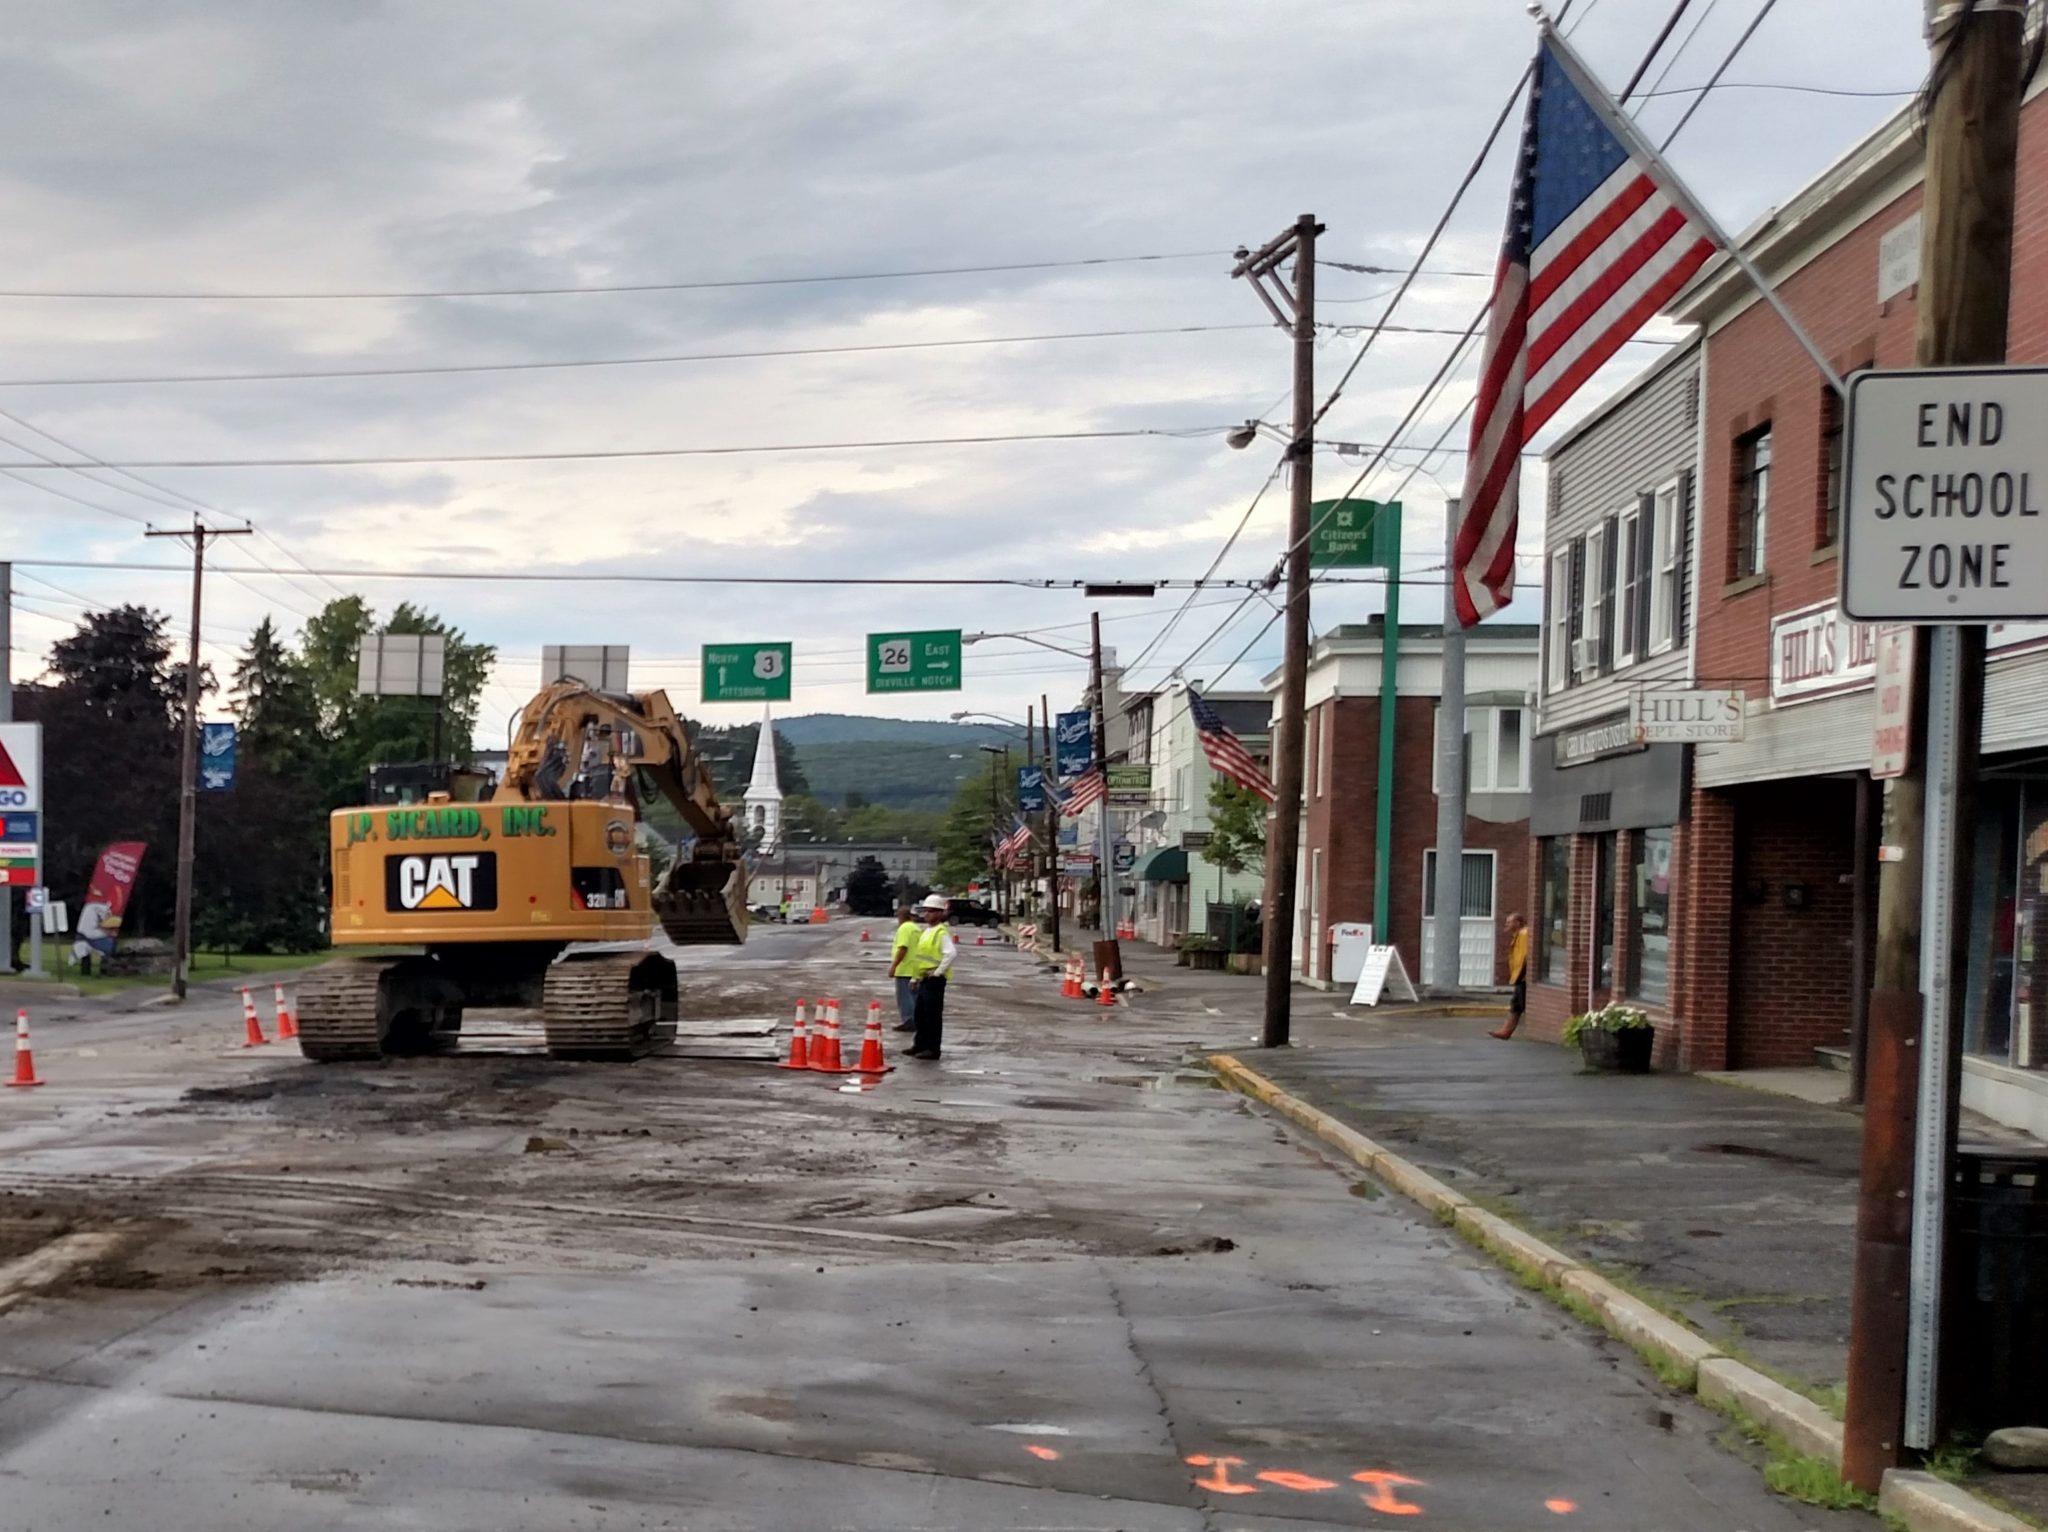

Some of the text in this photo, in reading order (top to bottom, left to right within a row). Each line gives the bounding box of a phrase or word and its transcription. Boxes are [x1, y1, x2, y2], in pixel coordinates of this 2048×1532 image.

[1917, 402, 2003, 447] END
[1874, 472, 2039, 519] SCHOOL
[1320, 529, 1367, 540] Citizens
[1328, 541, 1358, 553] Bank
[1898, 543, 2011, 589] ZONE
[884, 647, 909, 665] 26
[1780, 617, 1836, 684] HILL'S
[762, 655, 775, 673] 3
[719, 686, 767, 696] PITTSBURG
[875, 675, 953, 688] DIXVILLE NOTCH
[1637, 698, 1740, 722] HILL'S
[1634, 725, 1738, 738] DEPT. STORE
[347, 806, 556, 846] J.P. SICARD, INC.
[399, 855, 480, 909] CAT
